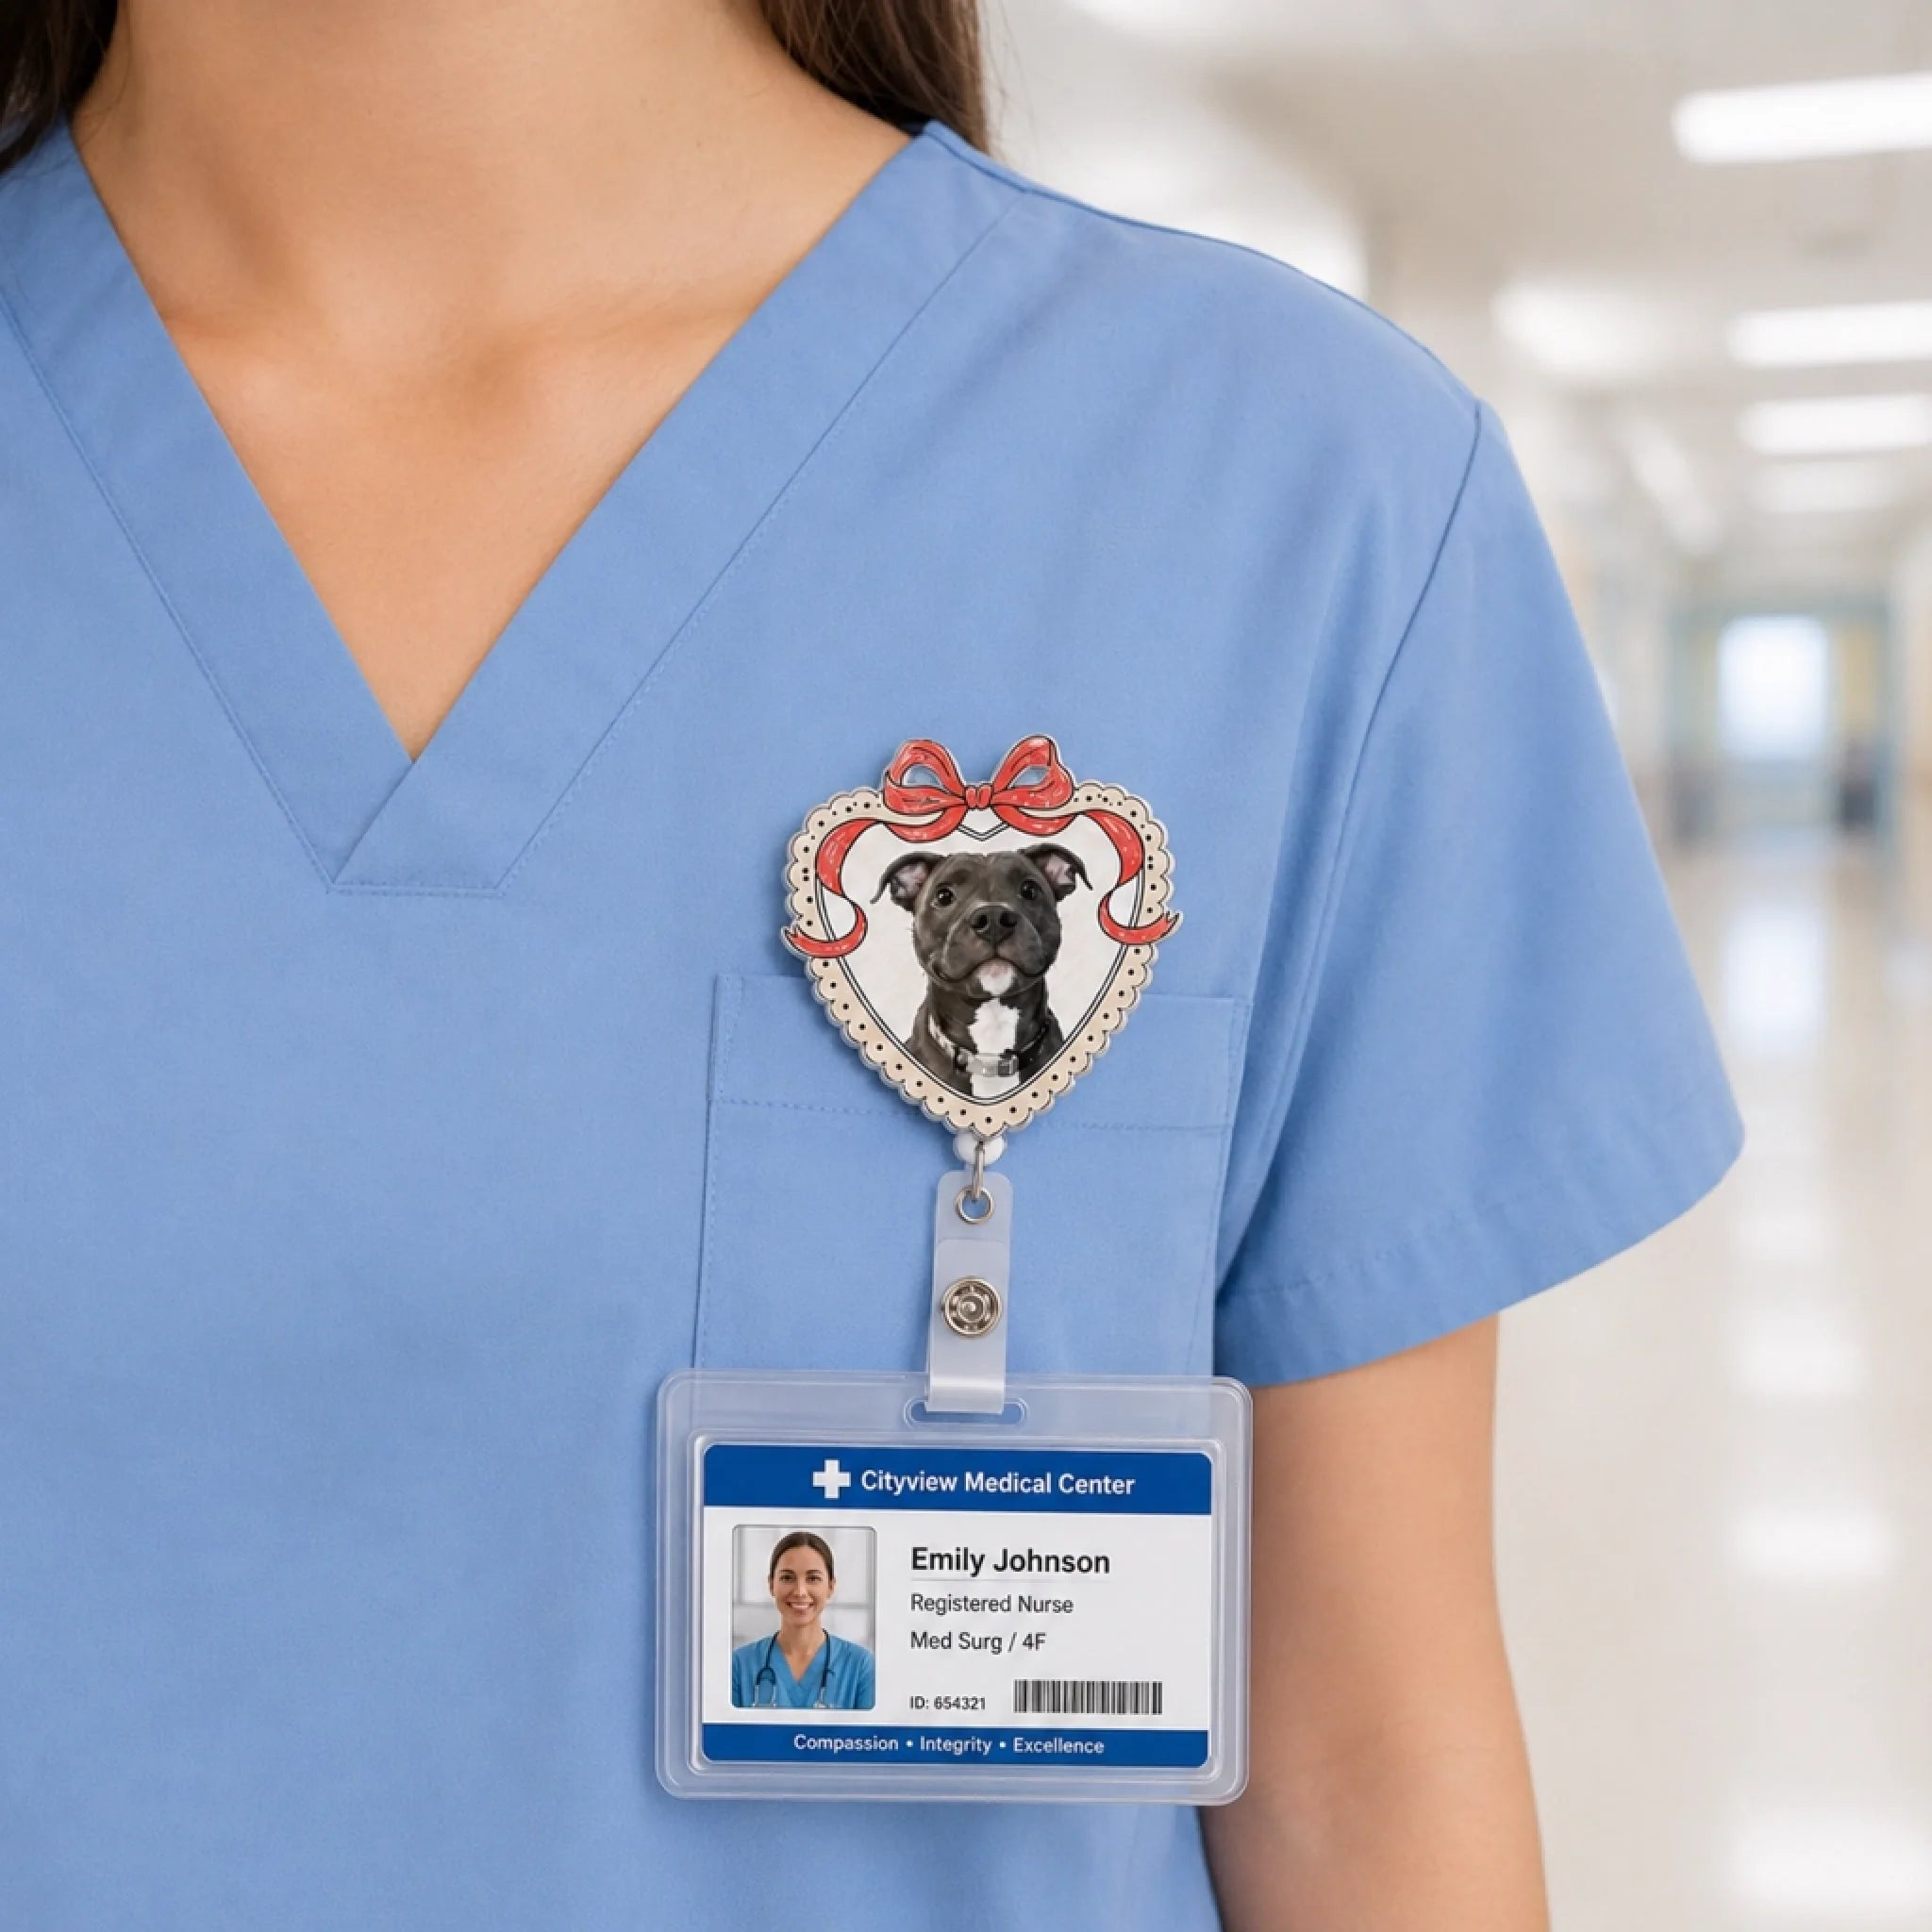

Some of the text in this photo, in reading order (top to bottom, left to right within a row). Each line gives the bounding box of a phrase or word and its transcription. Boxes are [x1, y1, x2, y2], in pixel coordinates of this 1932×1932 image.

[862, 1470, 1134, 1494] Cityview Medical Center
[911, 1547, 1109, 1577] Emily Johnson
[911, 1594, 1074, 1615] Registered Nurse
[911, 1632, 1045, 1655] Med Surg / 4F
[910, 1696, 985, 1709] ID: 654321
[794, 1734, 1104, 1755] Compassion Integrity Excellence
